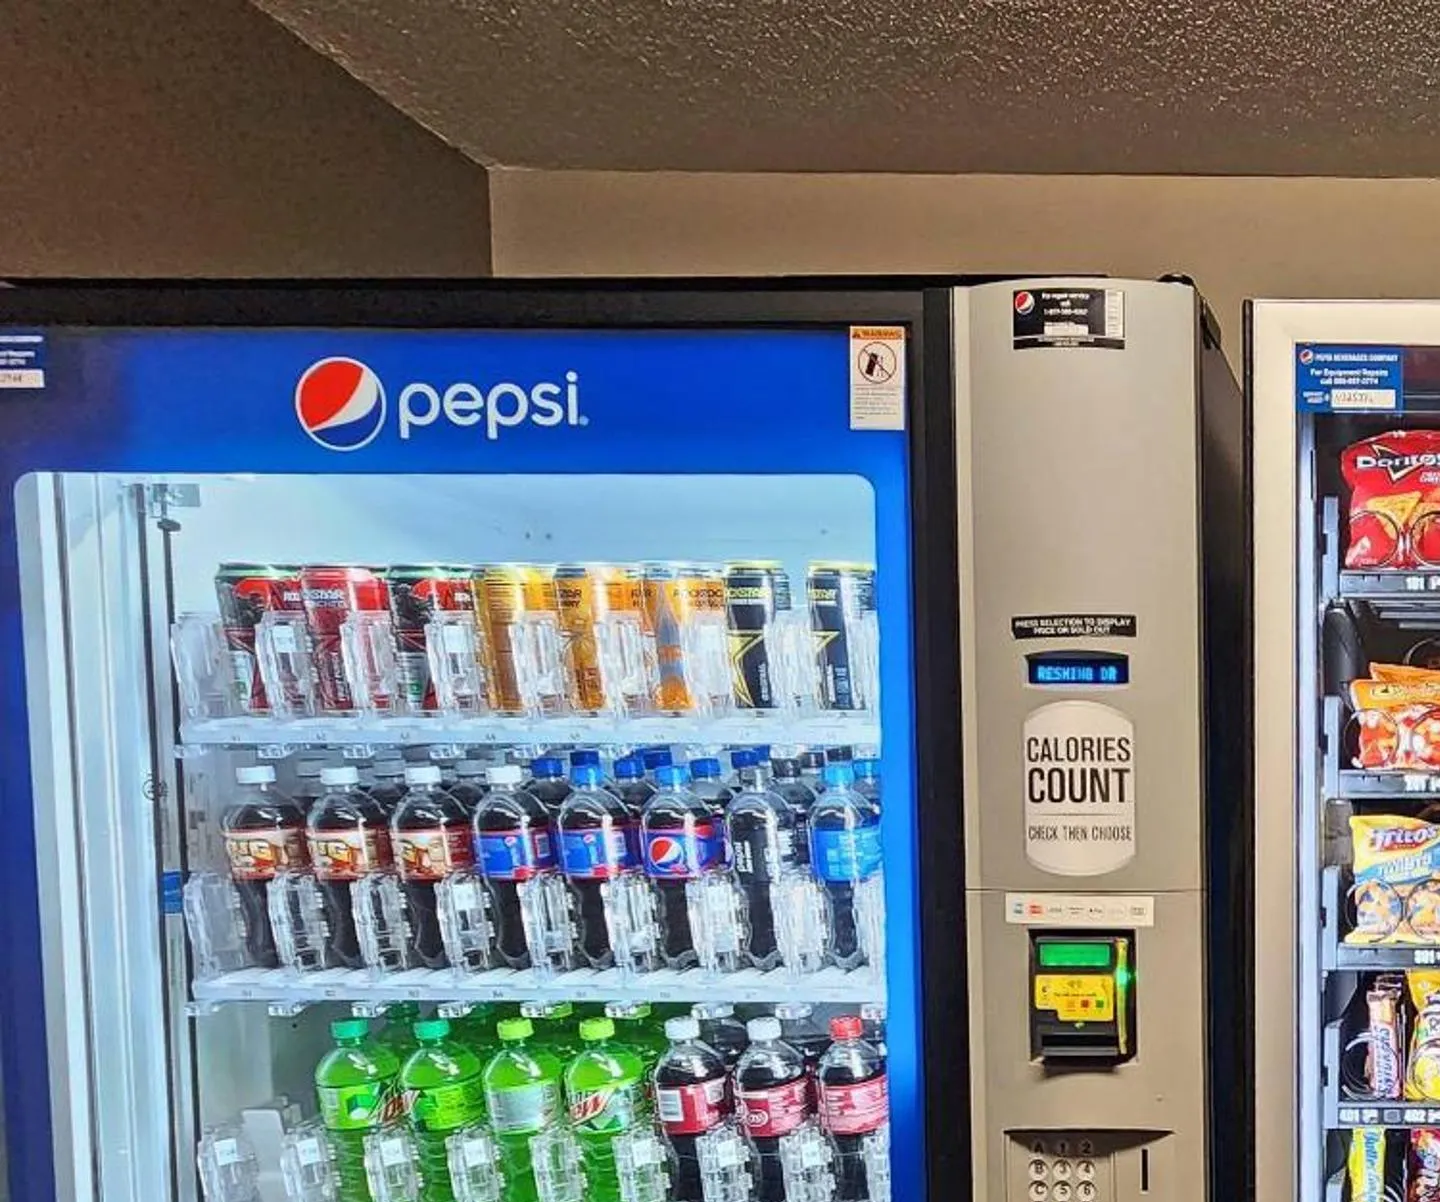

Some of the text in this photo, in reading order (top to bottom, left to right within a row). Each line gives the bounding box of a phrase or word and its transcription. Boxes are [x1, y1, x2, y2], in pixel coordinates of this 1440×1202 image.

[399, 371, 579, 440] pepsi
[1027, 736, 1131, 762] CALORIES
[1028, 767, 1131, 803] COUNT
[1028, 825, 1132, 841] CHECK THEN CHOOSE
[1034, 1141, 1091, 1153] A 1 2
[1034, 1162, 1091, 1173] B 3 4
[1034, 1184, 1091, 1195] C 5 6
